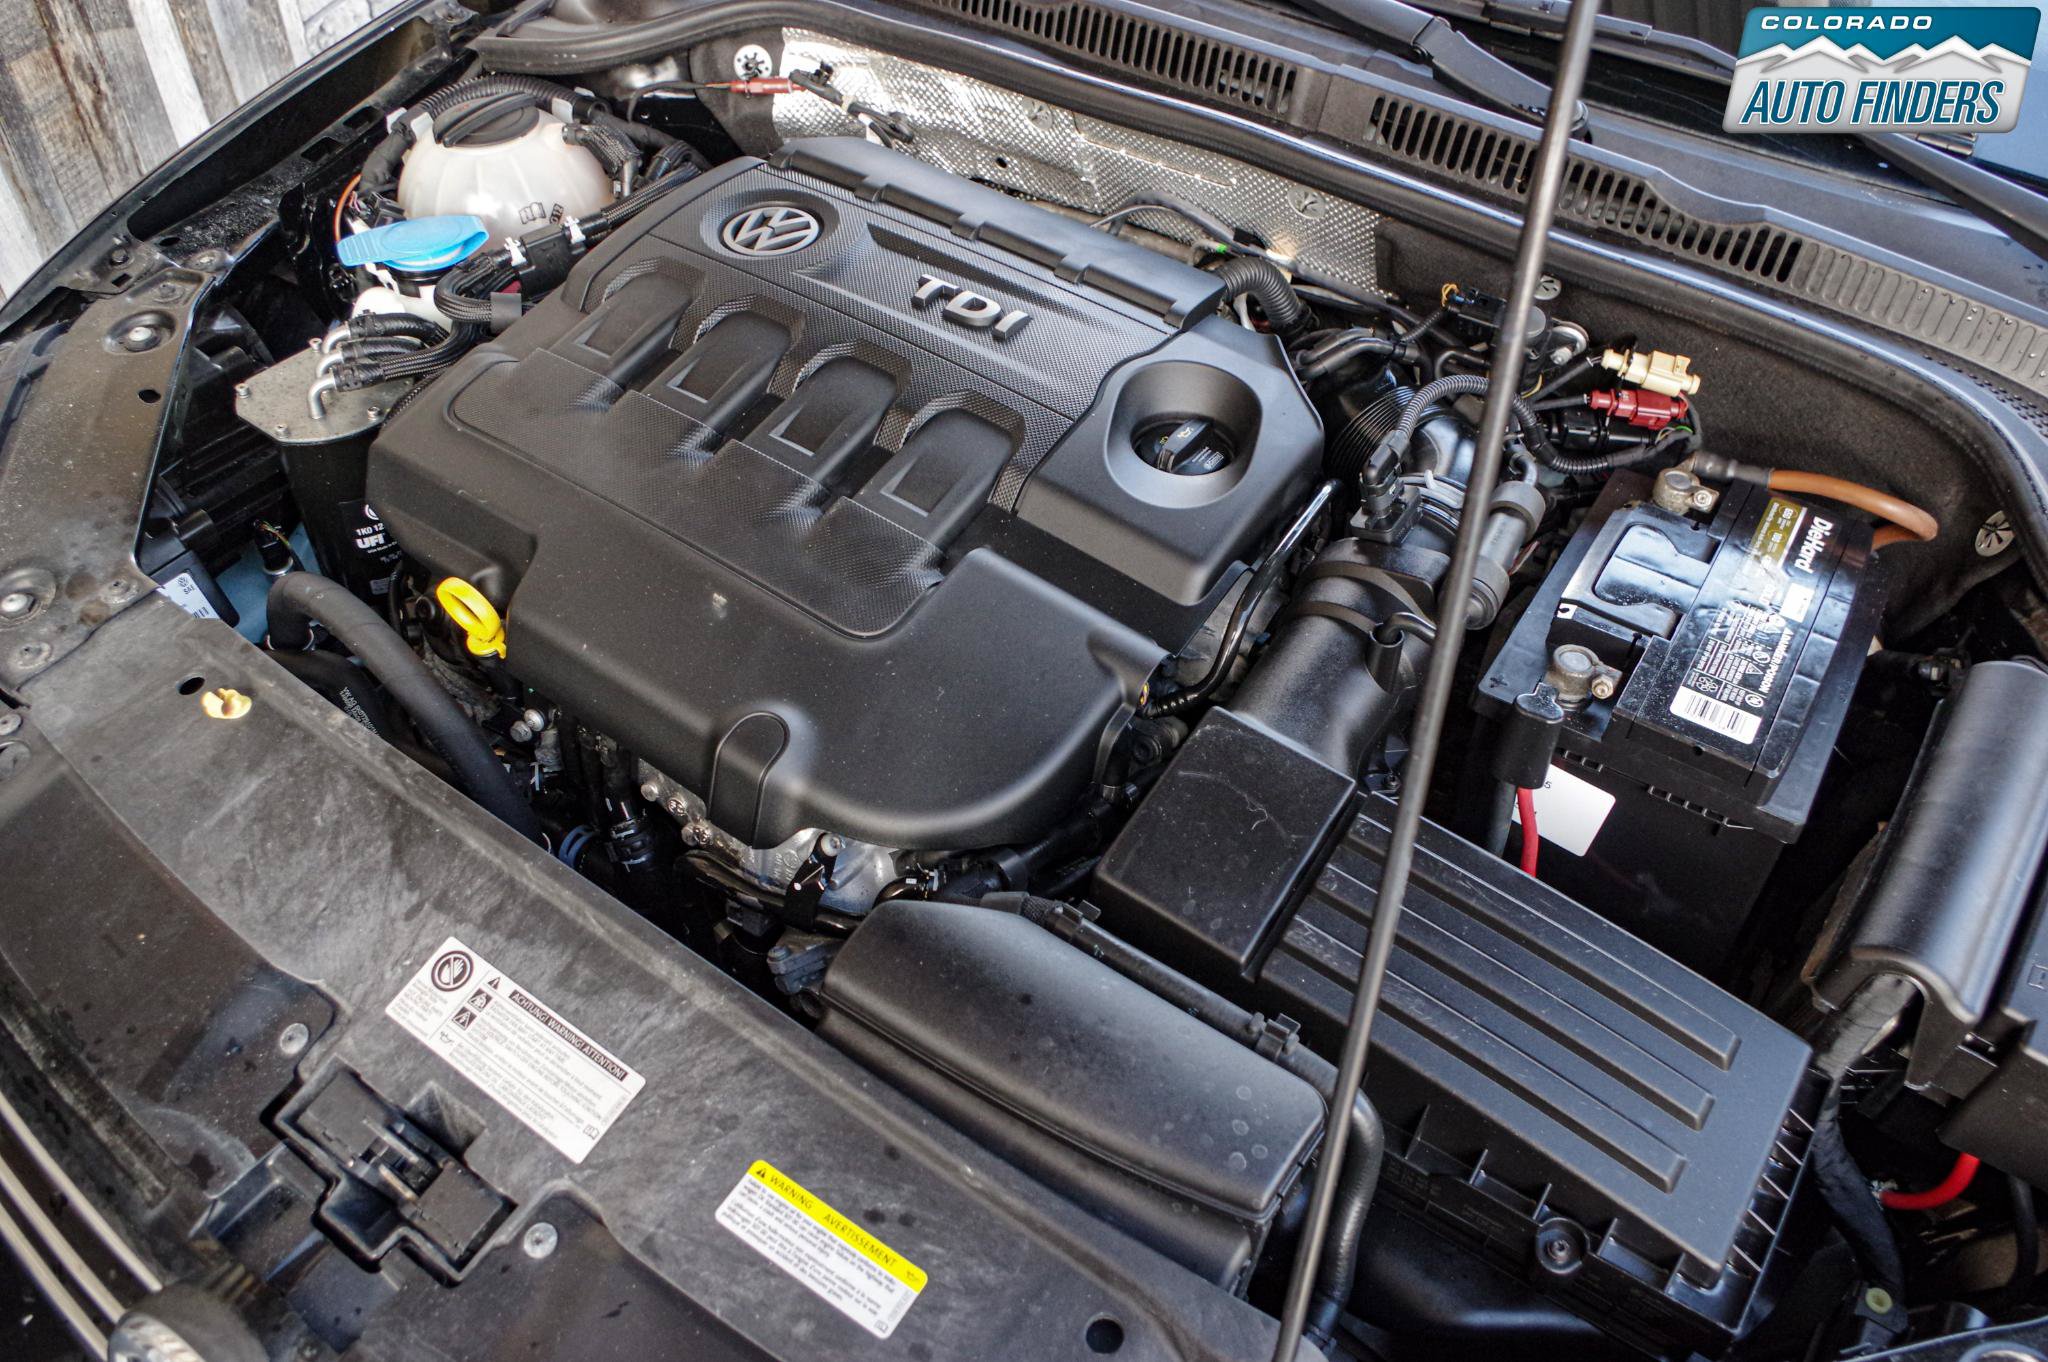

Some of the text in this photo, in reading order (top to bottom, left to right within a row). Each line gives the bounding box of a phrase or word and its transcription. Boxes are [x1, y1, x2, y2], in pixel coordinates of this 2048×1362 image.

[911, 274, 1032, 342] TDI
[356, 533, 385, 549] UFI
[1793, 516, 1834, 574] DieHard
[510, 991, 626, 1079] ACHTUNG! WARNING! ATTENTION!
[768, 1174, 897, 1268] WARNING AVERTISSEMENT
